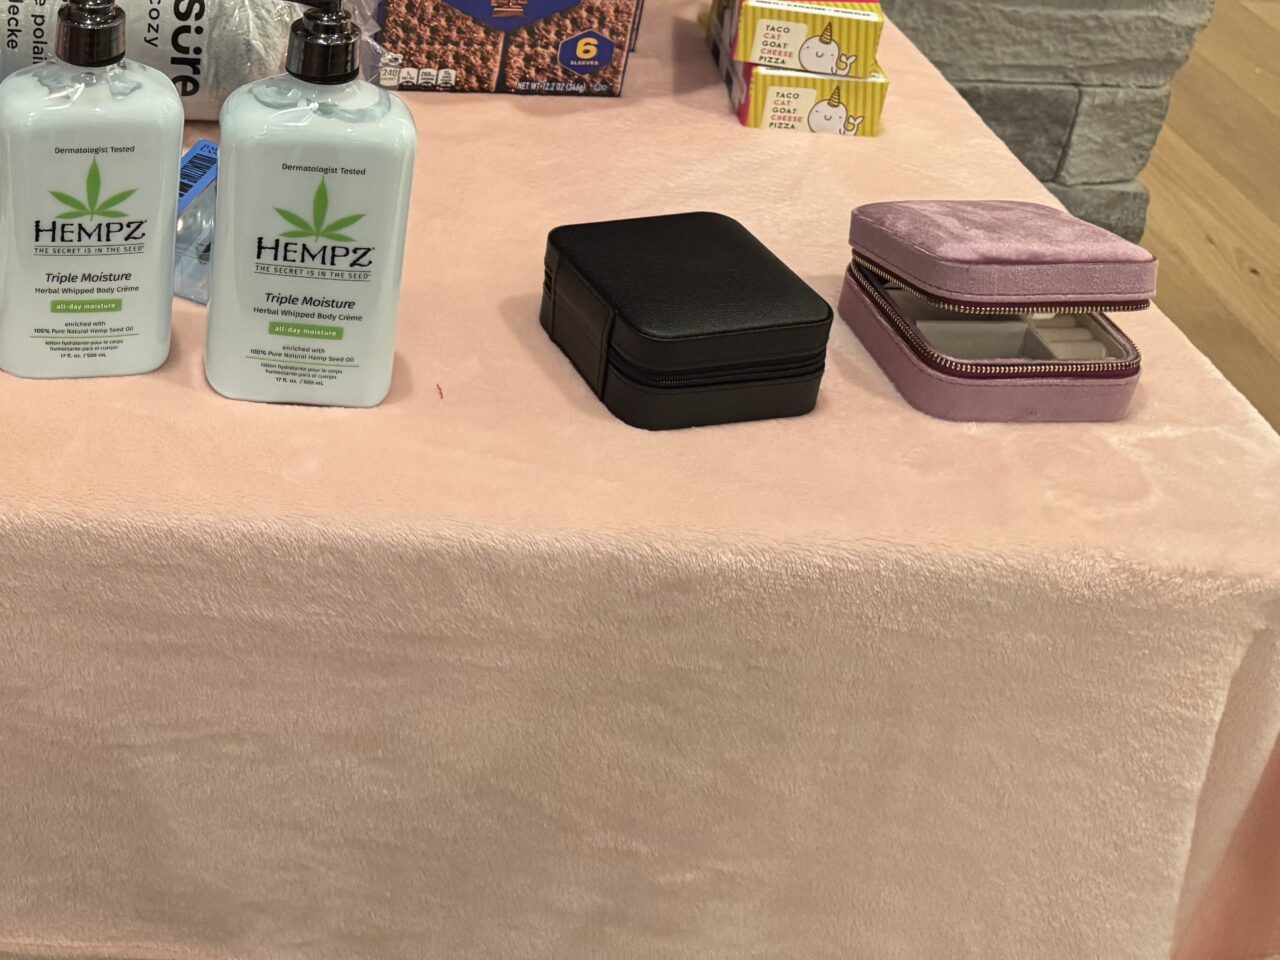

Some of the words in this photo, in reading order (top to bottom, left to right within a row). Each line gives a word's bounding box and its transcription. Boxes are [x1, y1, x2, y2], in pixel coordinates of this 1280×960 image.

[765, 25, 791, 34] TACO
[763, 33, 782, 41] CAT
[575, 37, 599, 59] 6
[762, 41, 788, 49] GOAT
[760, 48, 795, 58] CHEESE
[759, 56, 786, 65] PIZZA
[517, 81, 530, 90] NET
[556, 83, 564, 91] OZ
[775, 92, 800, 100] TACO
[771, 115, 803, 123] CHEESE
[769, 122, 796, 130] PIZZA
[55, 147, 108, 155] Dermatologist
[282, 163, 338, 175] Dermatologist
[340, 167, 366, 175] Tested
[35, 220, 146, 243] HEMPZ
[256, 237, 373, 268] HEMPZ
[46, 272, 79, 285] Triple
[81, 272, 132, 283] Moisture
[273, 267, 303, 275] SECRET
[307, 268, 315, 276] IS
[318, 269, 326, 277] IN
[349, 272, 369, 280] SEED
[62, 287, 94, 295] Whipped
[96, 287, 115, 295] Body
[265, 292, 299, 306] Triple
[301, 296, 356, 310] Moisture
[254, 307, 279, 316] Herbal
[281, 310, 315, 319] Whipped
[317, 312, 337, 321] Body
[274, 326, 301, 335] all-day
[303, 329, 337, 337] moisture
[282, 345, 310, 353] enriched
